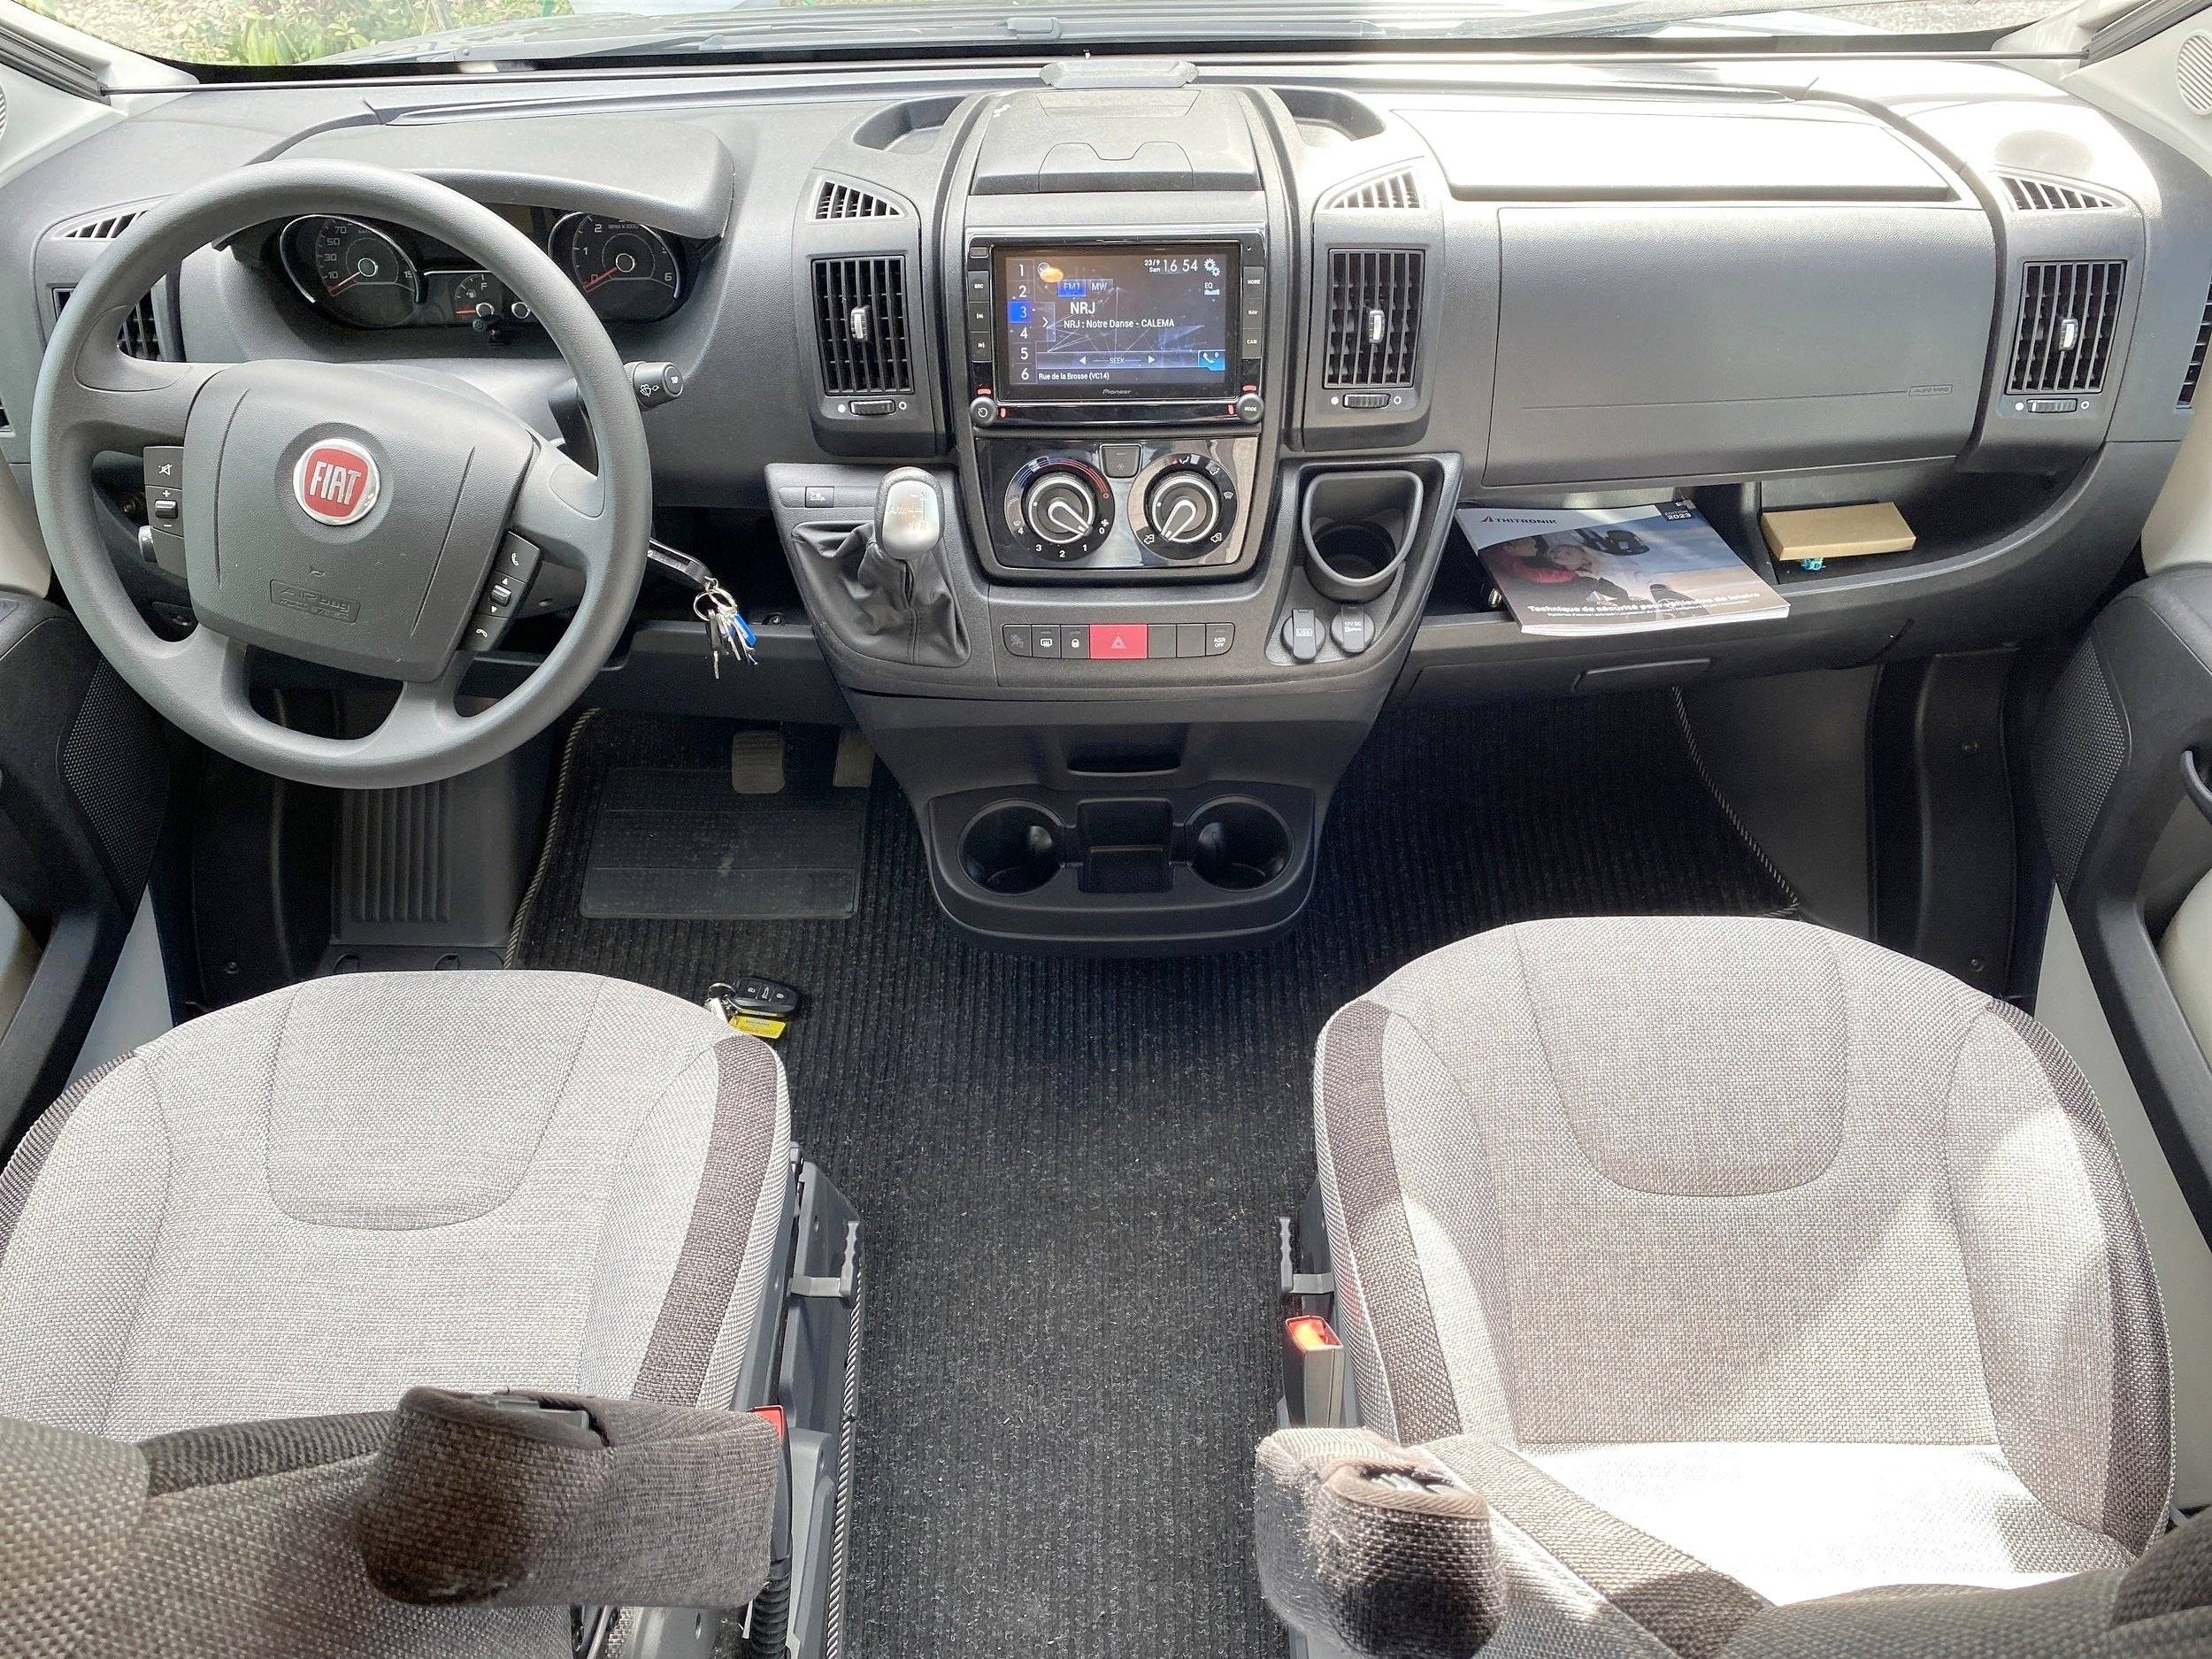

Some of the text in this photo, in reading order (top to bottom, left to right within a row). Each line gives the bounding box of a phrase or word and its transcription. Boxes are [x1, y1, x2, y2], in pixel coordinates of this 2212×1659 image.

[594, 224, 602, 233] 2
[326, 237, 340, 246] 50
[583, 247, 588, 256] 1
[1018, 264, 1024, 277] 1
[1164, 259, 1198, 272] 16 54
[664, 272, 672, 281] 6
[1018, 285, 1027, 297] 2
[1019, 306, 1027, 319] 3
[1070, 302, 1096, 314] NRJ
[1064, 319, 1080, 328] NRJ
[1086, 319, 1108, 328] Notre
[1109, 319, 1133, 328] Danse
[1141, 319, 1175, 327] CALEMA
[1019, 326, 1028, 339] 4
[1020, 347, 1028, 359] 5
[1021, 368, 1029, 380] 6
[1089, 372, 1110, 380] (VC14)
[309, 460, 362, 505] FIAT
